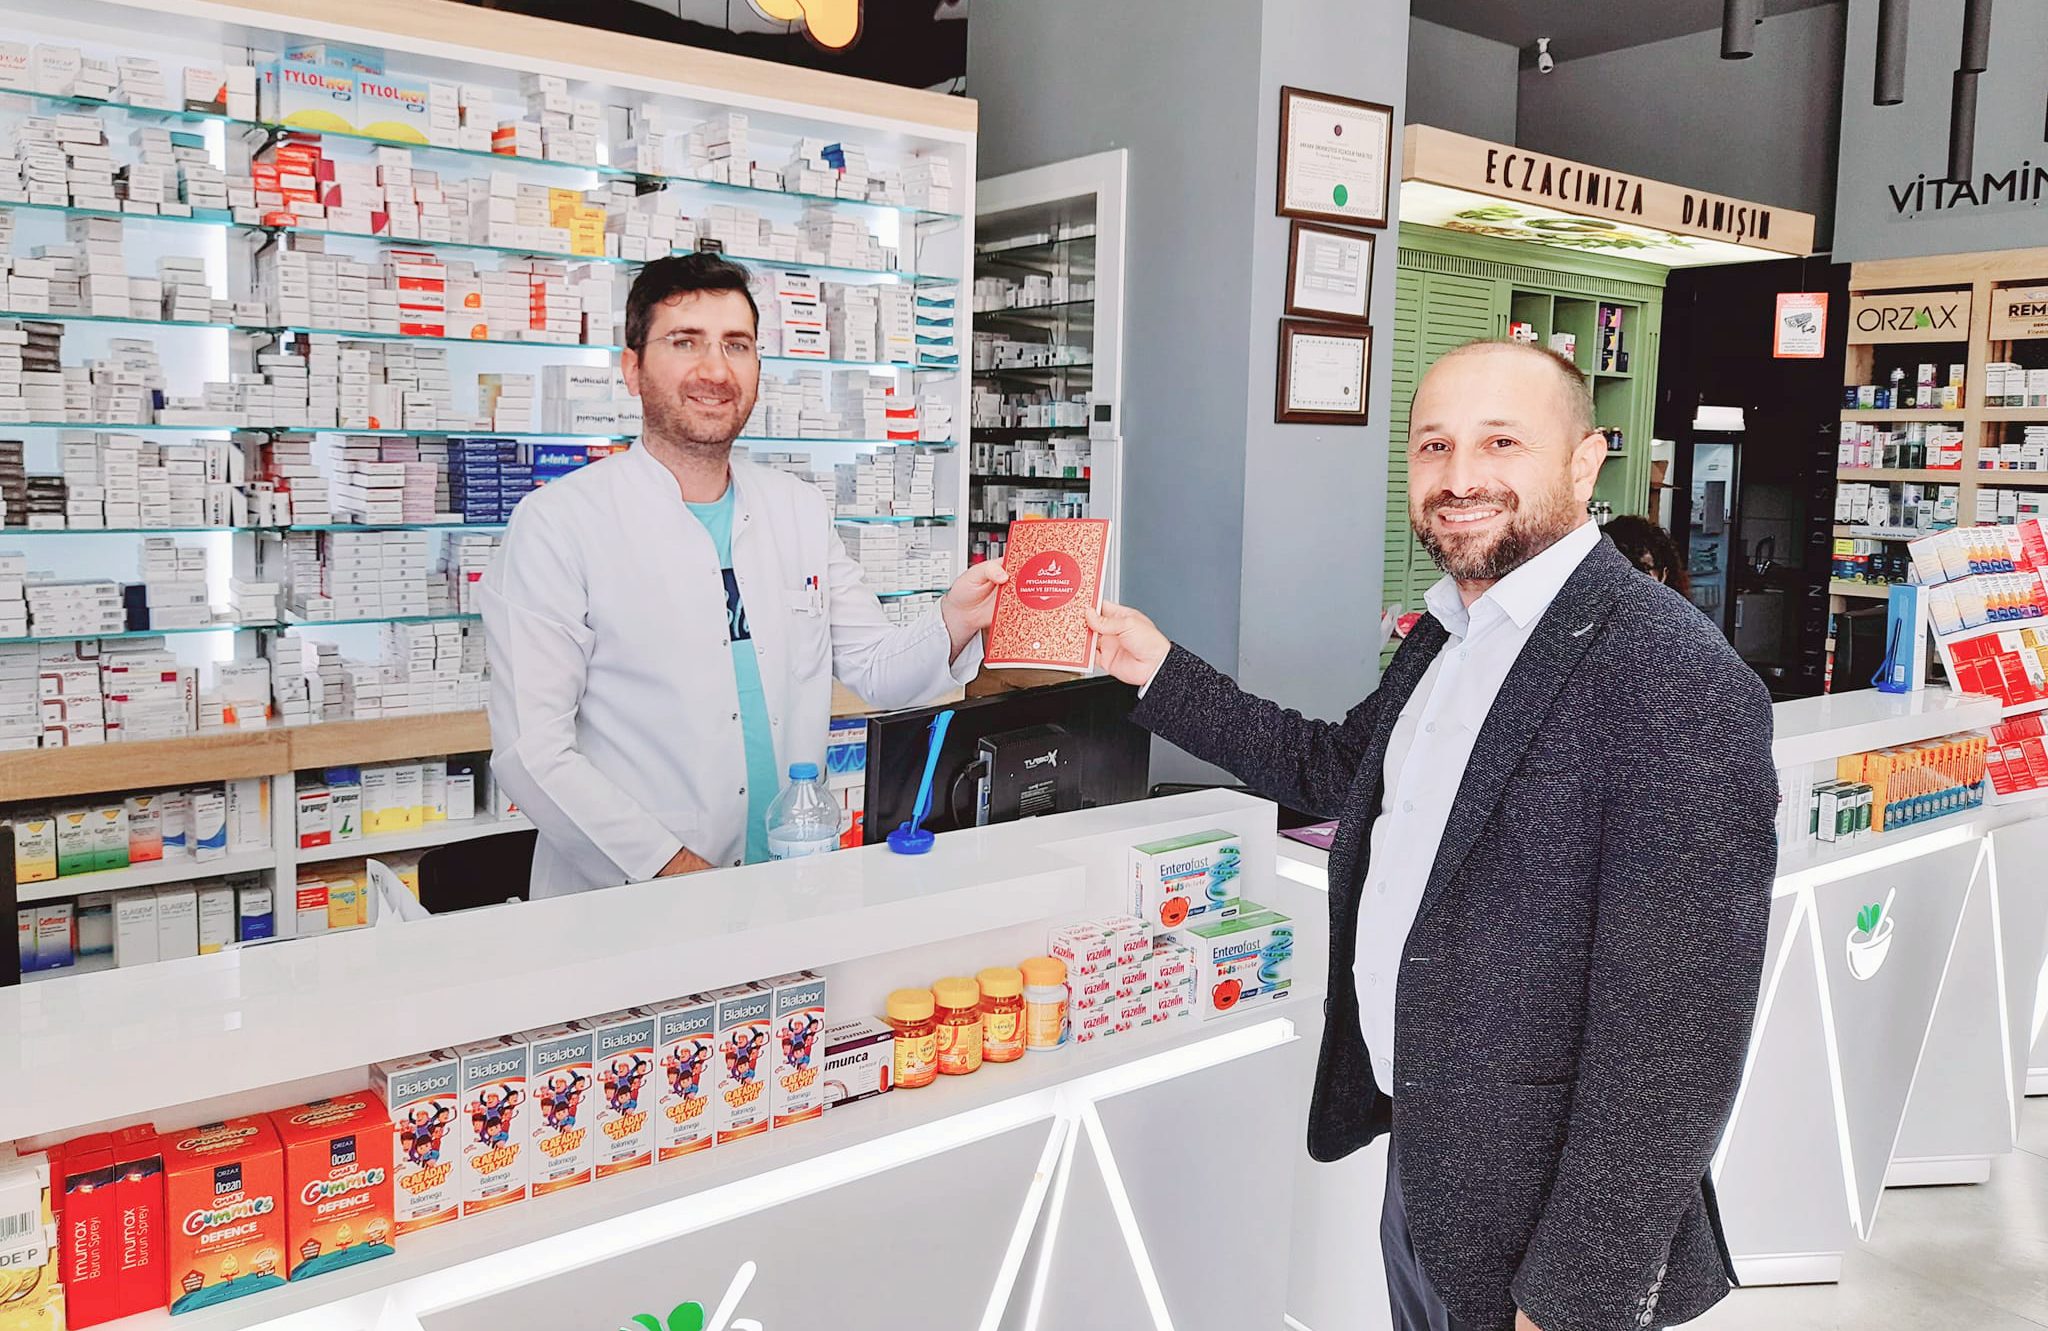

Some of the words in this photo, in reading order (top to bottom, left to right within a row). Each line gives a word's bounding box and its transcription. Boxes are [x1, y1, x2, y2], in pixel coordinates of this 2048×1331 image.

[1486, 149, 1643, 215] ECZACINIZA
[1682, 194, 1770, 242] DANIŞIN
[1856, 304, 1958, 332] ORZAX
[1160, 856, 1209, 877] Enterofast
[1212, 939, 1261, 959] Enterofast
[780, 989, 822, 1009] Bialabor
[723, 1002, 768, 1022] Bialabor
[665, 1015, 711, 1035] Bialabor
[602, 1029, 649, 1050] Bialabor
[537, 1044, 589, 1065] Bialabor
[469, 1057, 522, 1080] Bialabor
[396, 1073, 453, 1097] Bialabor
[331, 1151, 356, 1166] Ocean
[215, 1179, 242, 1195] Ocean
[301, 1167, 385, 1205] Gummies
[317, 1192, 370, 1215] DEFENCE
[182, 1195, 274, 1237] Gummies
[122, 1207, 137, 1271] Imumax
[200, 1221, 257, 1244] DEFENCE
[73, 1219, 89, 1284] Imumax
[137, 1235, 149, 1267] Burun
[89, 1247, 101, 1280] Burun
